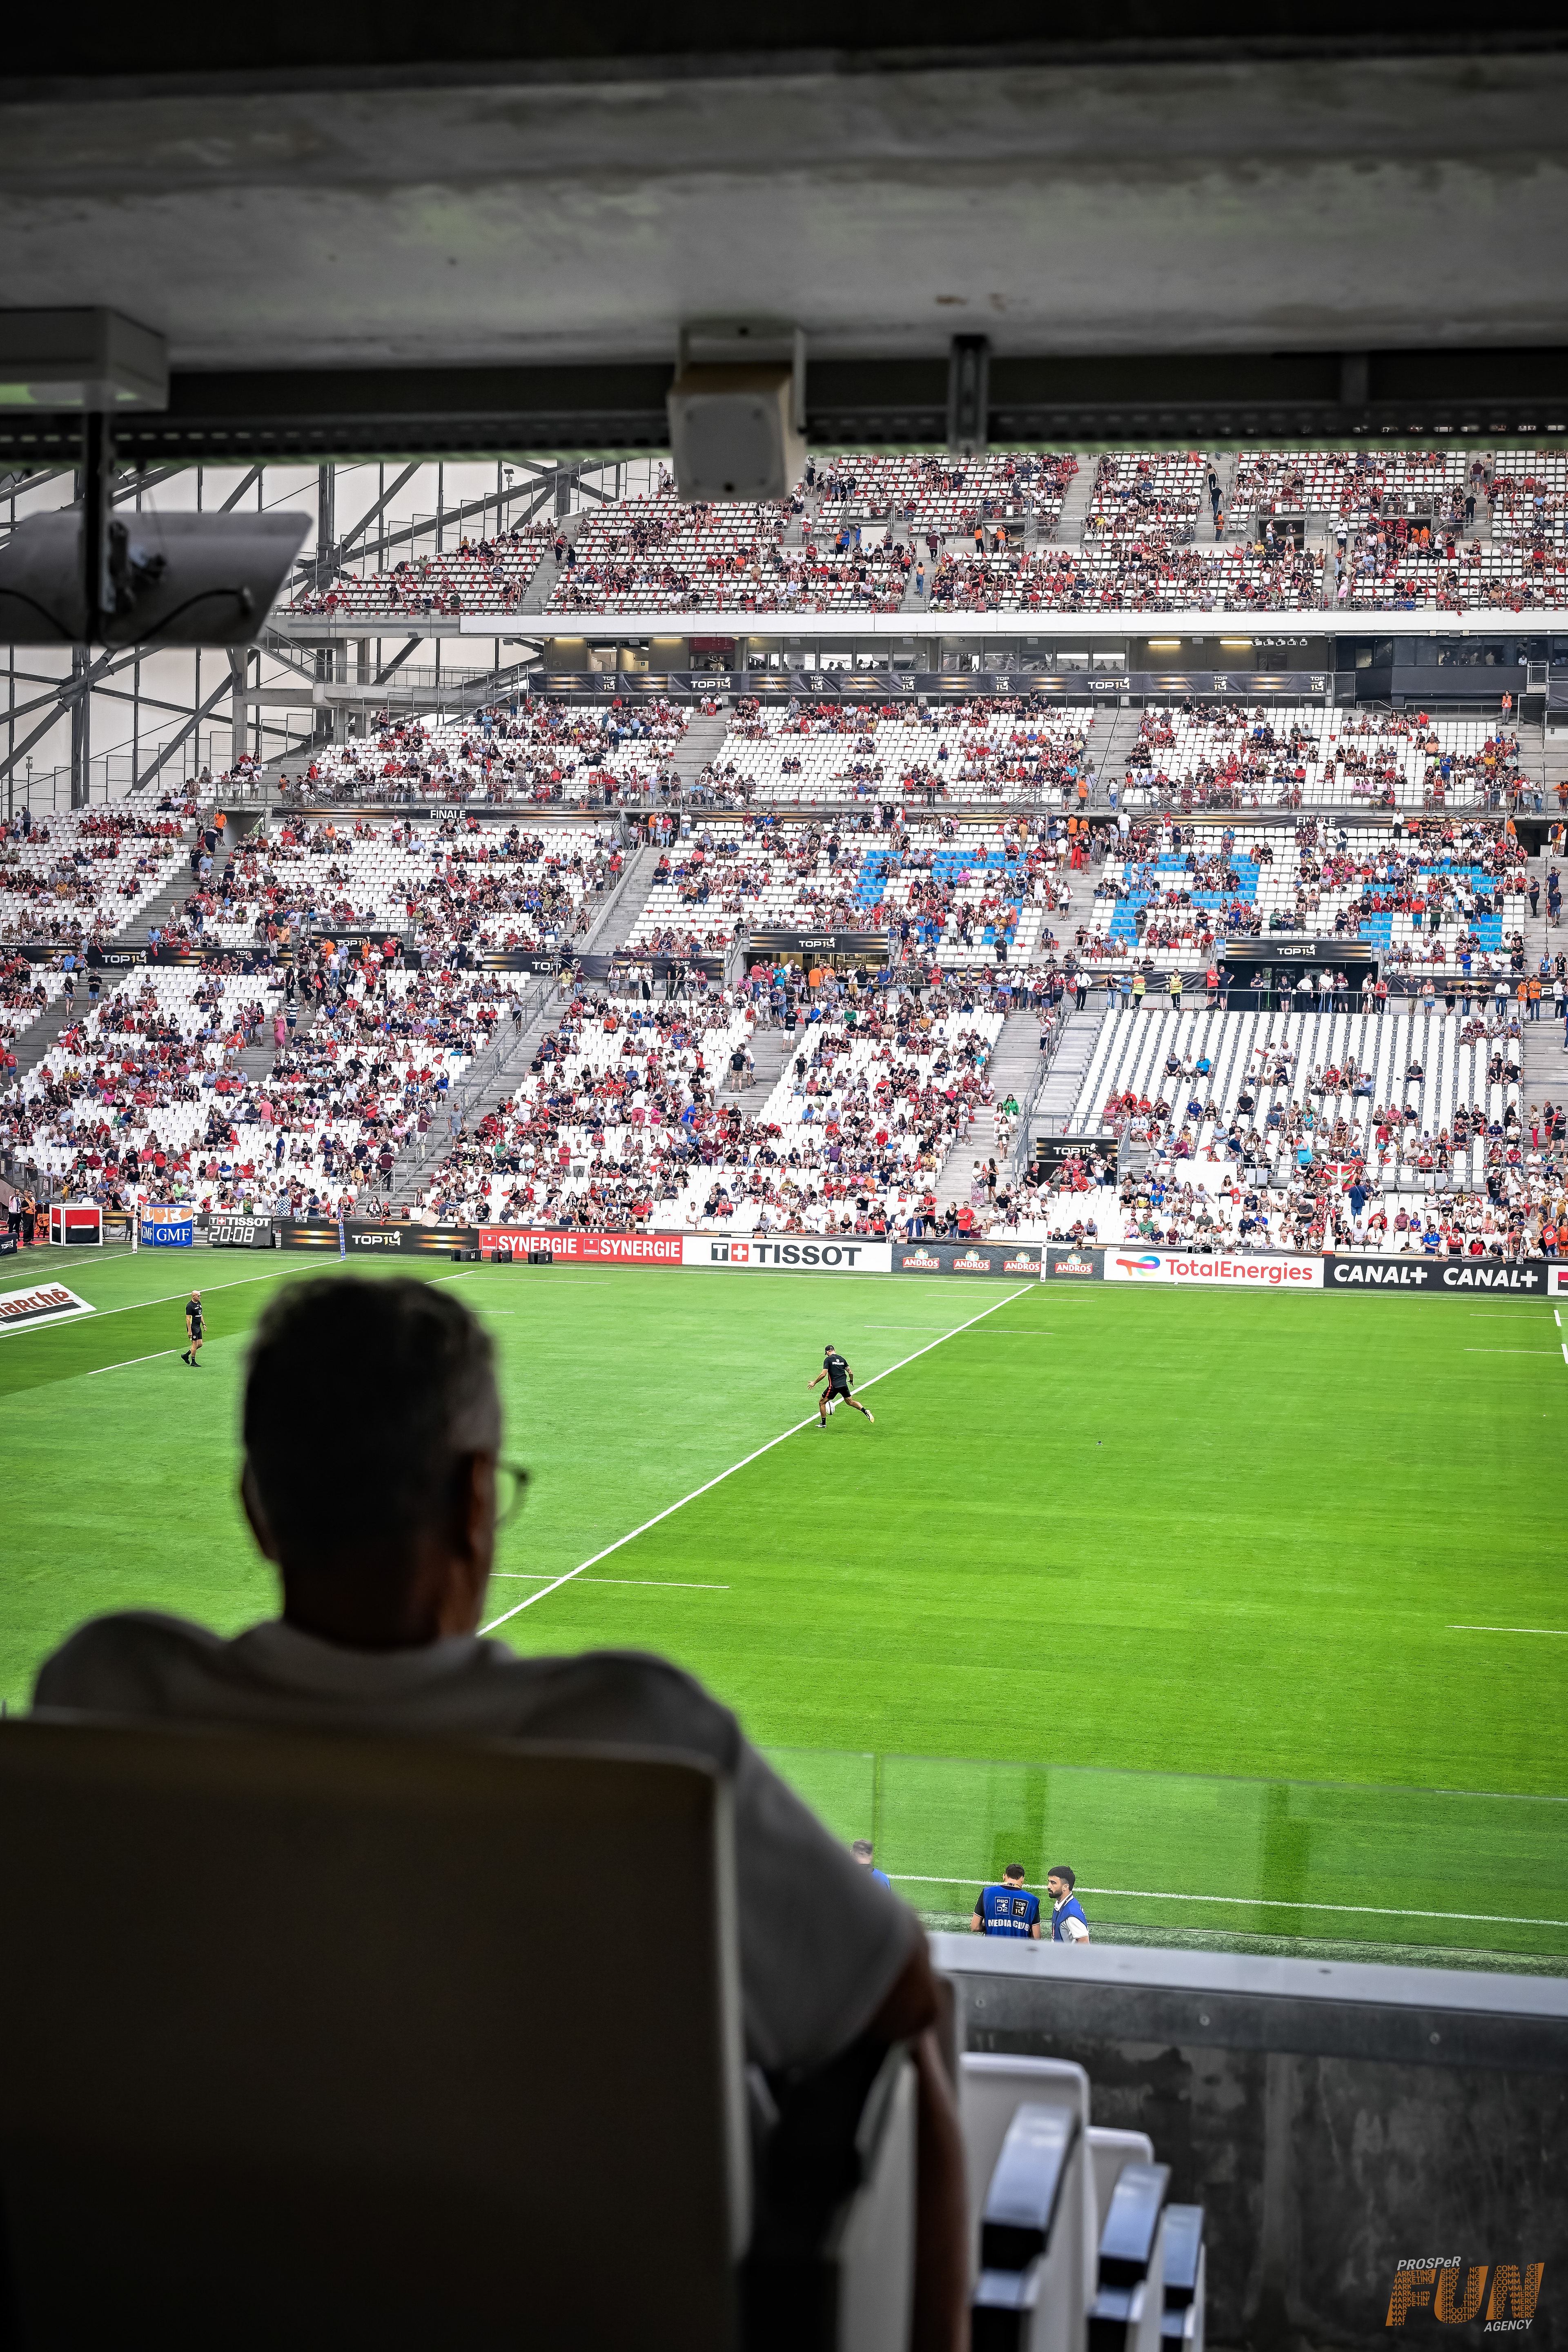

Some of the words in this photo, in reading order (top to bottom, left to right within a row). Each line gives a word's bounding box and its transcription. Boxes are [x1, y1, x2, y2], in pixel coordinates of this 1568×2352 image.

[430, 810, 466, 819] FINALE
[227, 1216, 272, 1227] TISSOT
[142, 1225, 153, 1240] GMF
[156, 1228, 190, 1241] GMF
[209, 1226, 255, 1242] 20:08
[499, 1235, 577, 1254] SYNERGIE
[600, 1239, 680, 1257] SYNERGIE
[753, 1243, 862, 1266] TISSOT
[904, 1258, 939, 1267] ANDROS
[954, 1260, 989, 1269] ANDROS
[1005, 1262, 1040, 1271] ANDROS
[1056, 1264, 1091, 1273] ANDROS
[1166, 1259, 1312, 1284] TotalEnergies
[1334, 1264, 1428, 1284] CANAL+
[1443, 1267, 1538, 1287] CANAL+
[988, 1919, 1012, 1927] MEDIA
